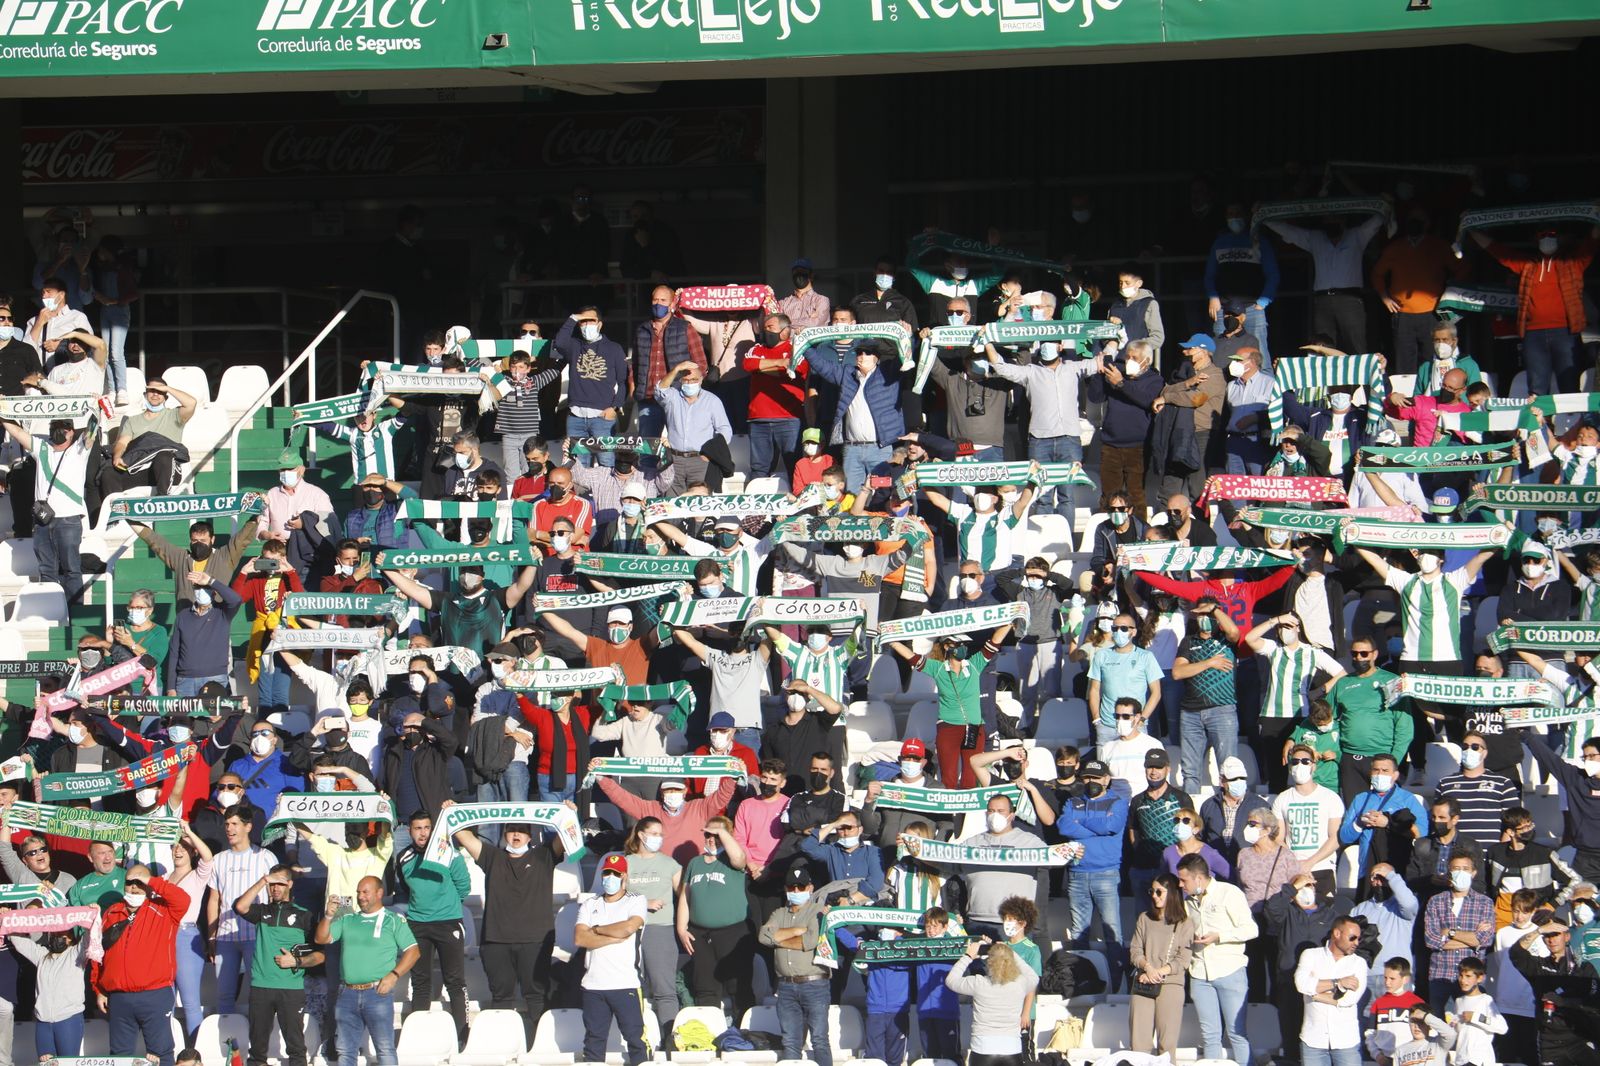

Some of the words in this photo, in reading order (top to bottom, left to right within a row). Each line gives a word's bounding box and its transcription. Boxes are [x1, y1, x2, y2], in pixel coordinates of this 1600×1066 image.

[52, 0, 183, 35] PACC
[320, 0, 447, 31] PACC
[69, 42, 87, 57] de
[91, 41, 157, 61] Seguros
[258, 36, 332, 53] Correduría
[335, 35, 353, 51] de
[357, 35, 422, 55] Seguros
[707, 289, 746, 299] MUJER
[692, 298, 761, 309] CORDOBESA
[1063, 323, 1084, 336] CF
[13, 398, 91, 414] CÓRDOBA
[1392, 449, 1483, 464] CÓRDOBA
[1250, 479, 1294, 490] MUJER
[1234, 488, 1311, 500] CORDOBESA
[1494, 486, 1579, 504] CÓRDOBA
[134, 498, 210, 515] CÓRDOBA
[214, 495, 237, 510] CF
[1392, 528, 1456, 541] CÓRDOBA
[393, 552, 483, 567] CÓRDOBA
[620, 558, 690, 573] CÓRDOBA
[355, 596, 371, 611] CF
[775, 600, 858, 615] CÓRDOBA
[25, 662, 40, 674] DE
[1414, 679, 1485, 698] CÓRDOBA
[1493, 685, 1518, 698] C.F.
[162, 697, 204, 713] INFINITA
[1474, 711, 1503, 723] With
[1466, 718, 1504, 736] Coke
[127, 755, 181, 782] BARCELONA
[689, 756, 705, 767] CF
[1478, 781, 1496, 791] 23
[287, 797, 365, 813] CÓRDOBA
[533, 806, 560, 819] CF
[1286, 808, 1320, 825] CORE
[923, 843, 969, 861] PARQUE
[971, 845, 1003, 862] CRUZ
[1004, 847, 1050, 863] CONDE
[1377, 1007, 1410, 1023] FILA
